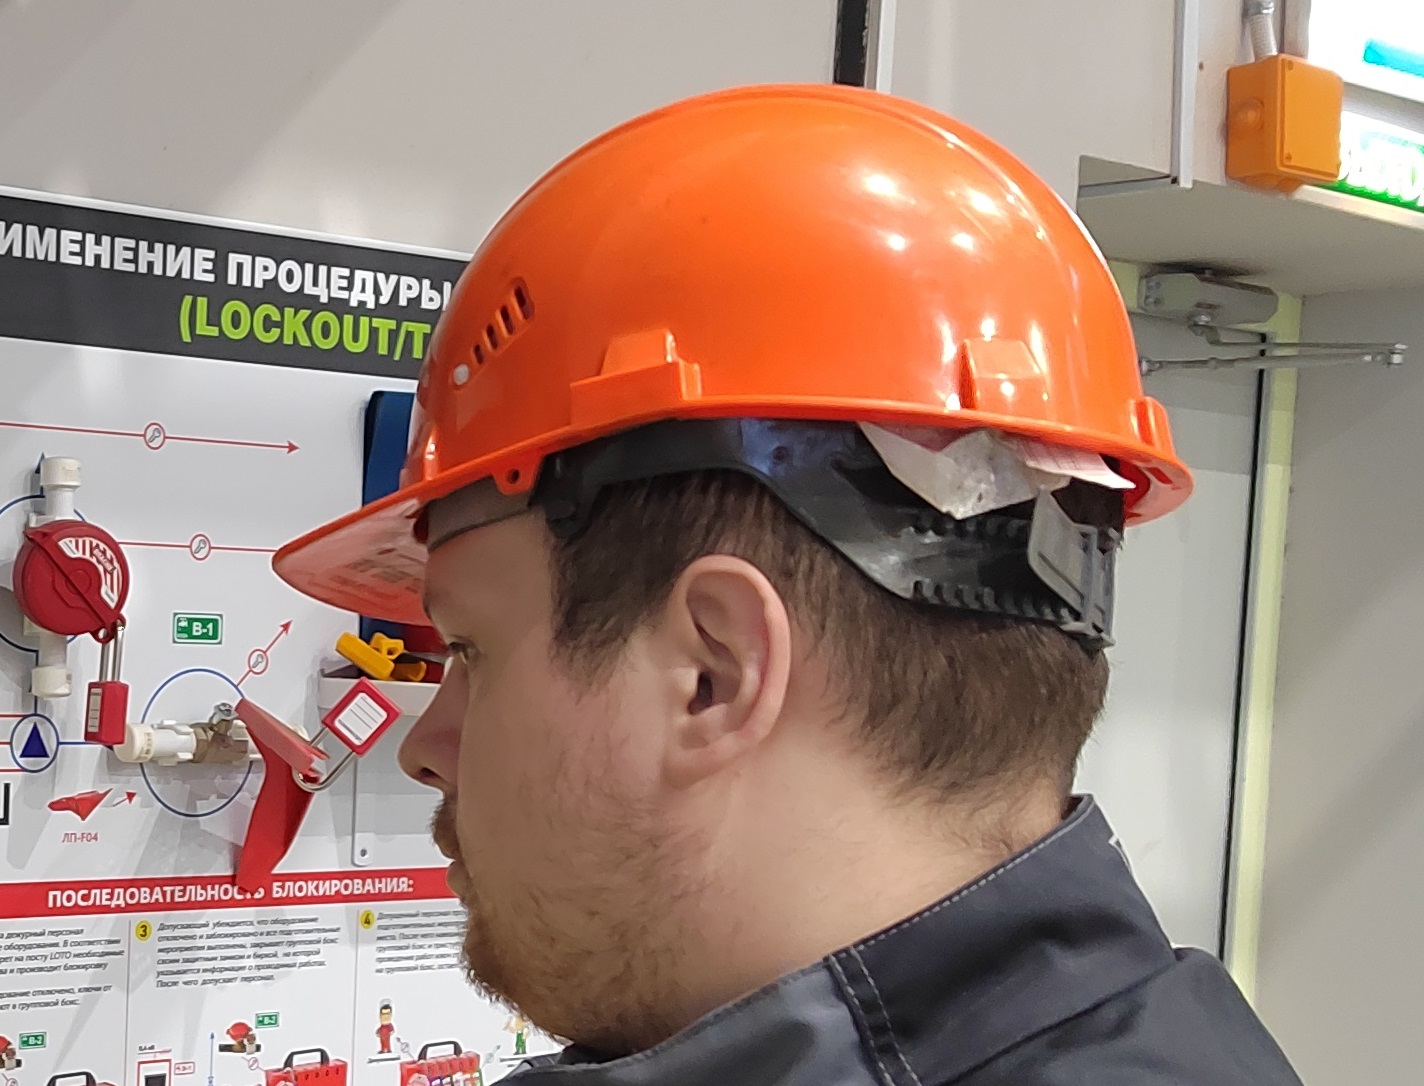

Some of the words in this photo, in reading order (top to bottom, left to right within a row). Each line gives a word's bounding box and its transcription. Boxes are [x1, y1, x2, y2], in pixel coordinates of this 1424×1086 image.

[227, 252, 452, 311] ПРОЦЕДУРЫ
[179, 295, 431, 361] (LOCKOUT/T
[192, 621, 214, 637] В-1
[61, 832, 98, 843] ЛП-F04
[48, 883, 266, 908] ПОСЛЕДОВАТЕЛЬНОСЬ
[272, 876, 414, 898] БЛОКИРОВАНИЯ:
[140, 924, 147, 938] 3
[50, 951, 71, 961] LOTO
